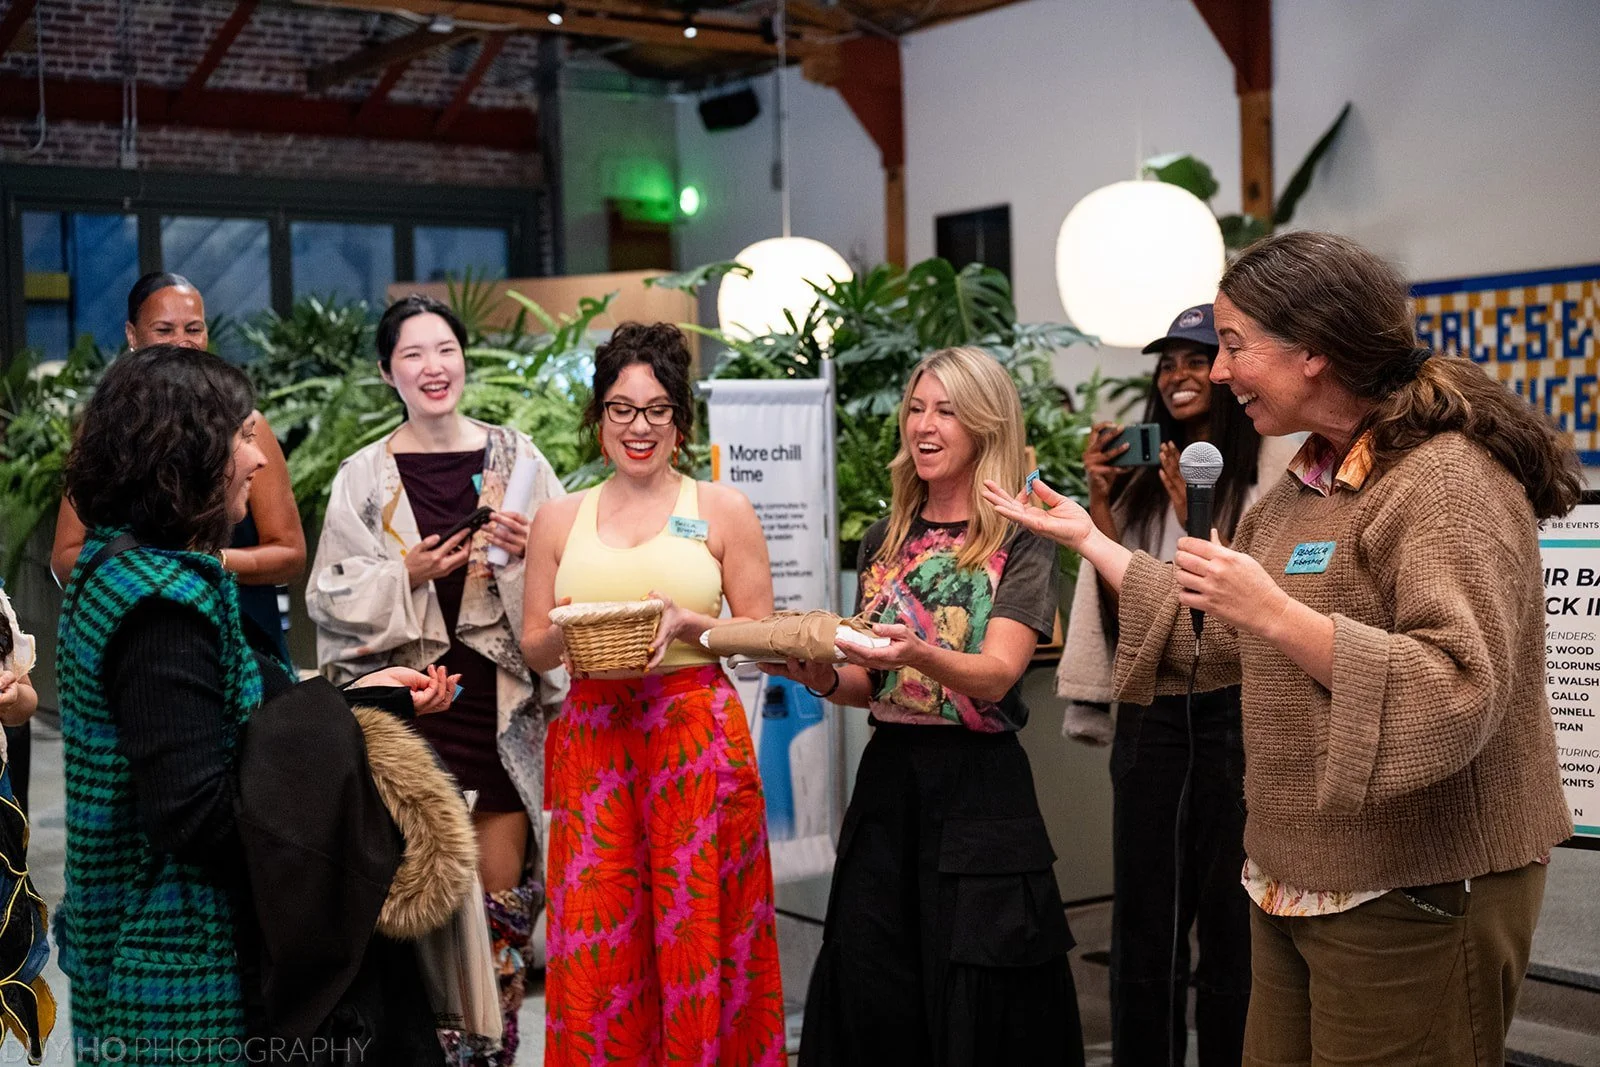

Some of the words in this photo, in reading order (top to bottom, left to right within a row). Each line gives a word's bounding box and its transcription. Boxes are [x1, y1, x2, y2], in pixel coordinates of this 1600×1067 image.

[1416, 304, 1548, 363] SALES
[729, 445, 768, 461] More
[771, 444, 802, 461] chill
[730, 465, 763, 482] time
[1545, 597, 1581, 616] CK
[1556, 646, 1594, 655] WOOD
[1558, 676, 1600, 686] WALSH
[1552, 692, 1589, 701] GALLO
[1550, 707, 1596, 717] ONNELL
[1554, 722, 1584, 732] TRAN
[1559, 763, 1595, 773] MOMO
[1562, 778, 1595, 788] KNITS
